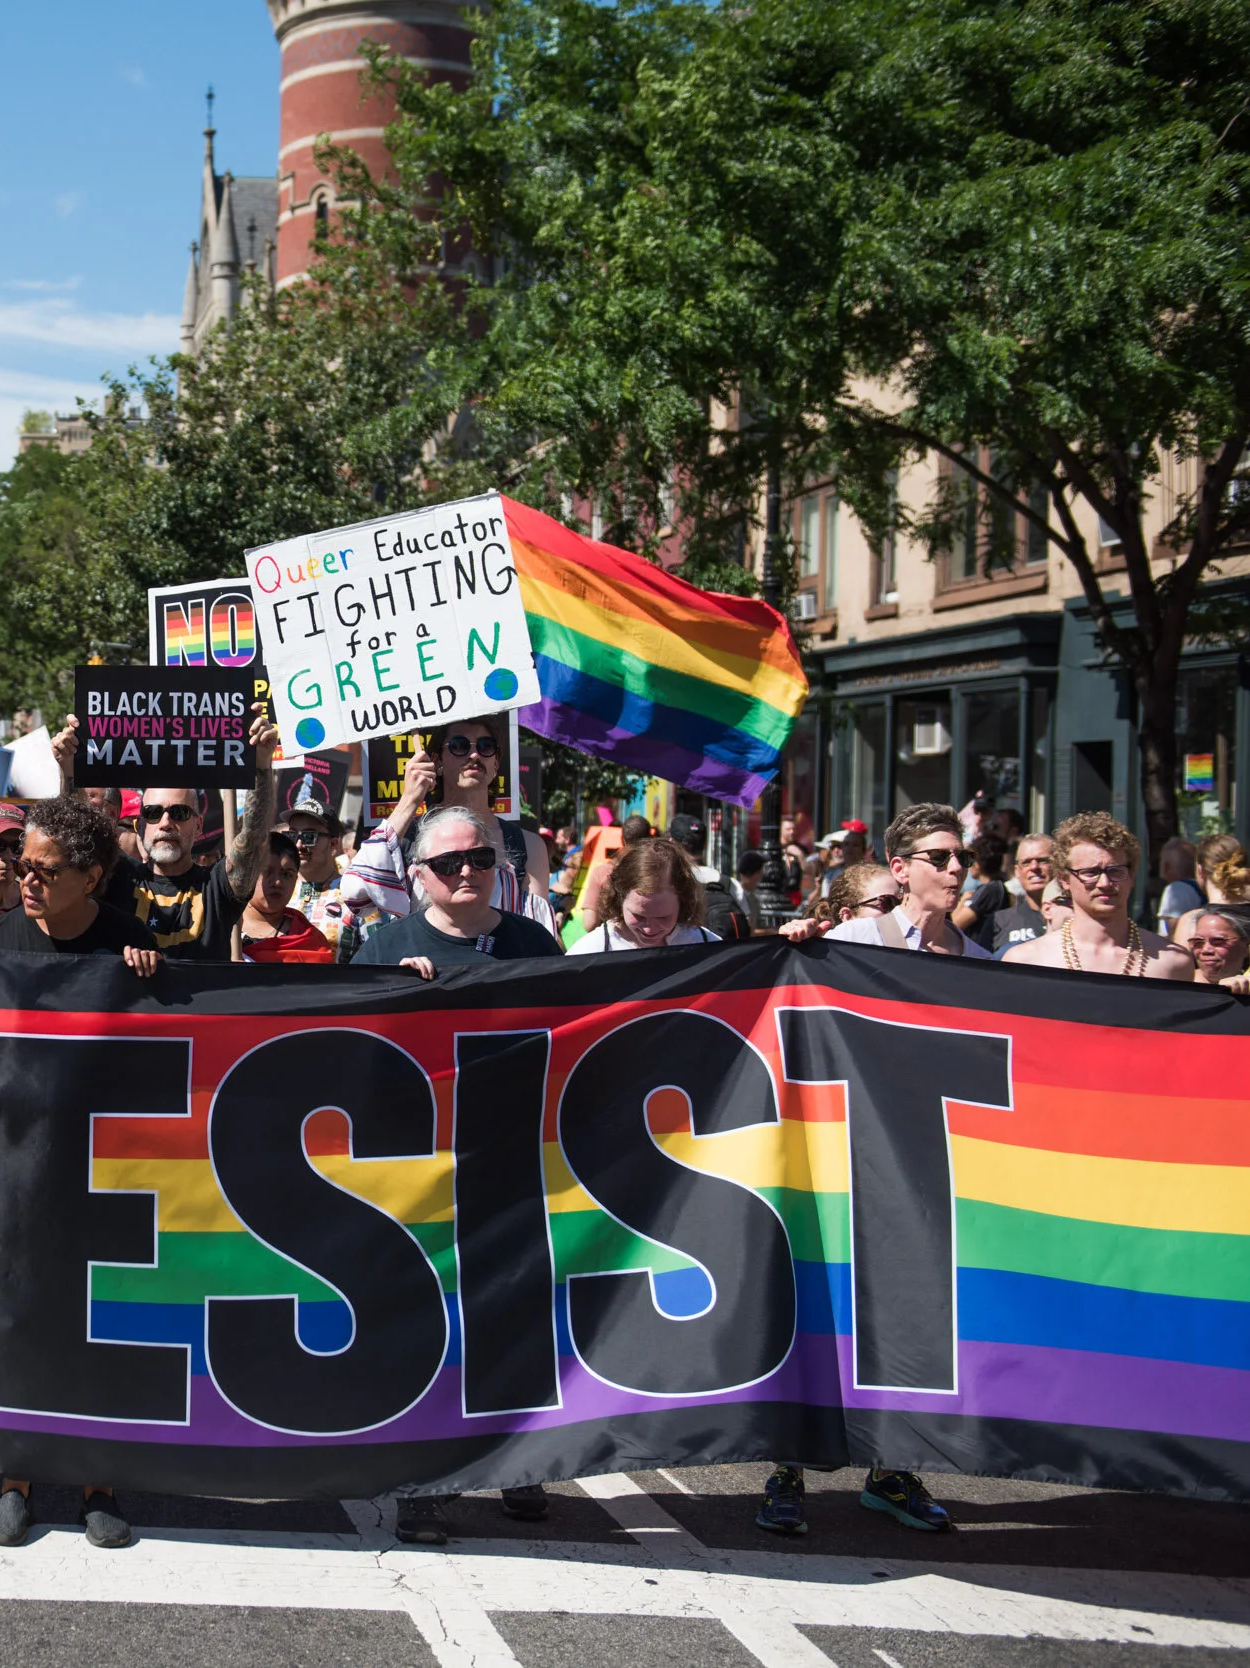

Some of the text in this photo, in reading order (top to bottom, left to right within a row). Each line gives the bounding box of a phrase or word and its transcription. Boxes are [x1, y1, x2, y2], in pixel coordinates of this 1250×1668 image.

[254, 513, 503, 594] Queer Educator
[273, 543, 518, 643] FIGHTING
[346, 622, 430, 658] for a
[286, 621, 501, 711] GREEN
[87, 691, 163, 716] BLACK
[168, 692, 245, 717] TRANS
[350, 685, 457, 733] WORLD
[87, 716, 184, 738] WOMEN'S
[189, 716, 244, 738] LIVES
[87, 739, 245, 767] MATTER
